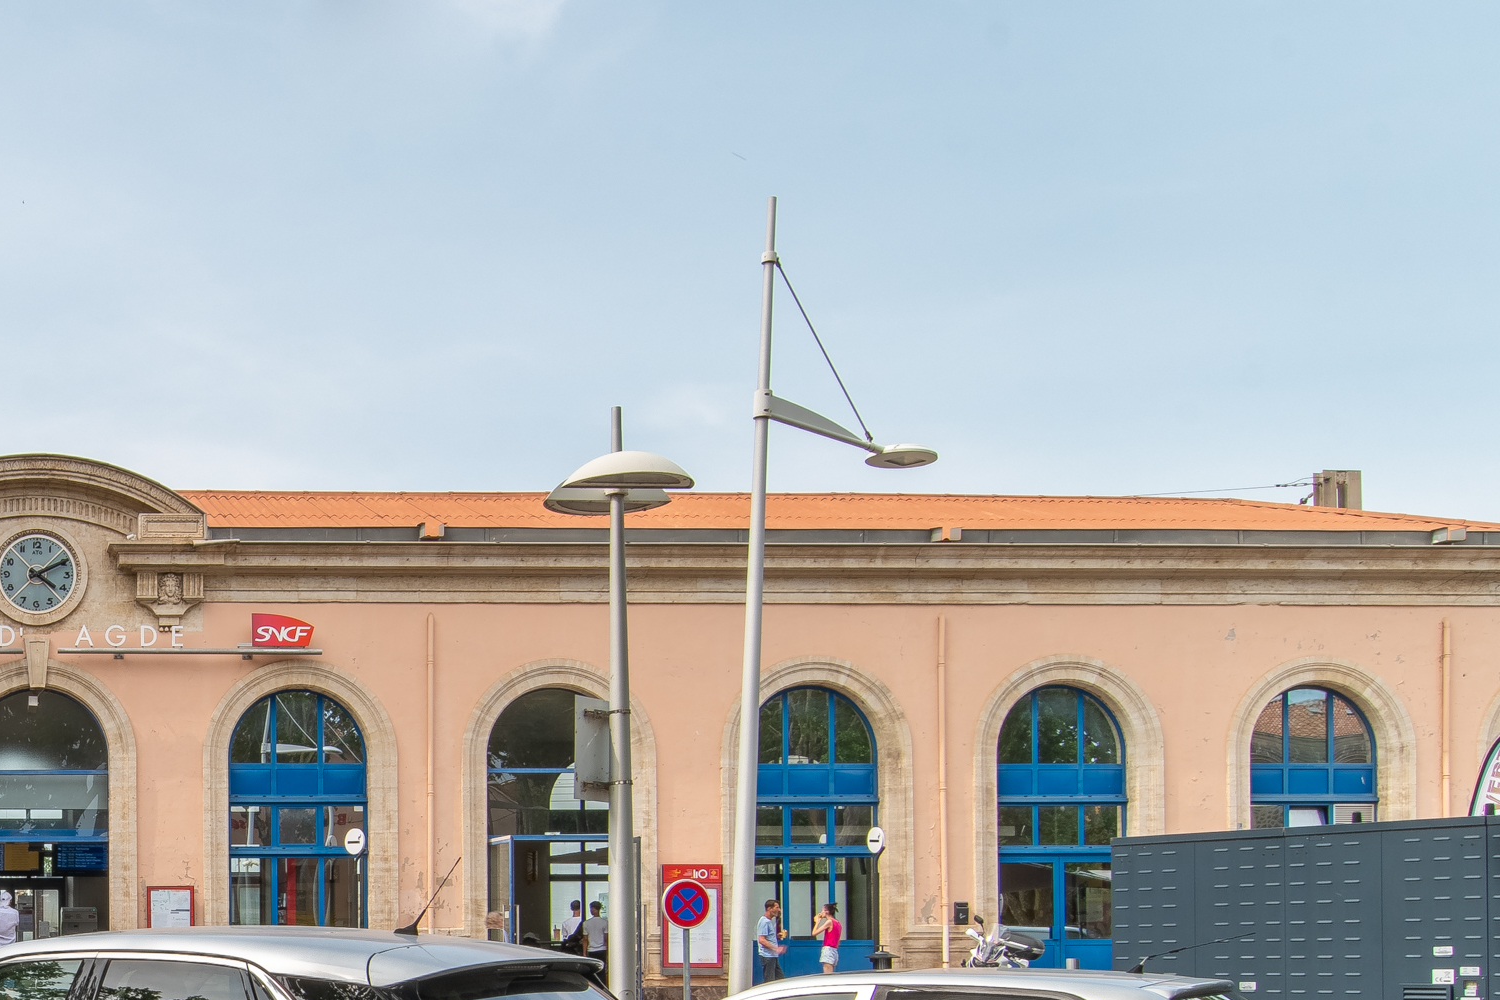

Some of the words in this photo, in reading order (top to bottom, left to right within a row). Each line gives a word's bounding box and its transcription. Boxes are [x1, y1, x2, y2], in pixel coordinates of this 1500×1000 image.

[20, 545, 25, 553] 11
[32, 541, 42, 549] 12
[48, 545, 52, 553] 1
[6, 558, 14, 566] 10
[3, 570, 11, 578] 9
[63, 571, 70, 579] 3
[7, 583, 14, 591] 8
[59, 583, 67, 591] 4
[20, 596, 27, 604] 7
[32, 600, 40, 608] 6
[46, 597, 53, 605] 5
[74, 624, 184, 647] AGDE
[254, 625, 312, 643] SNCF
